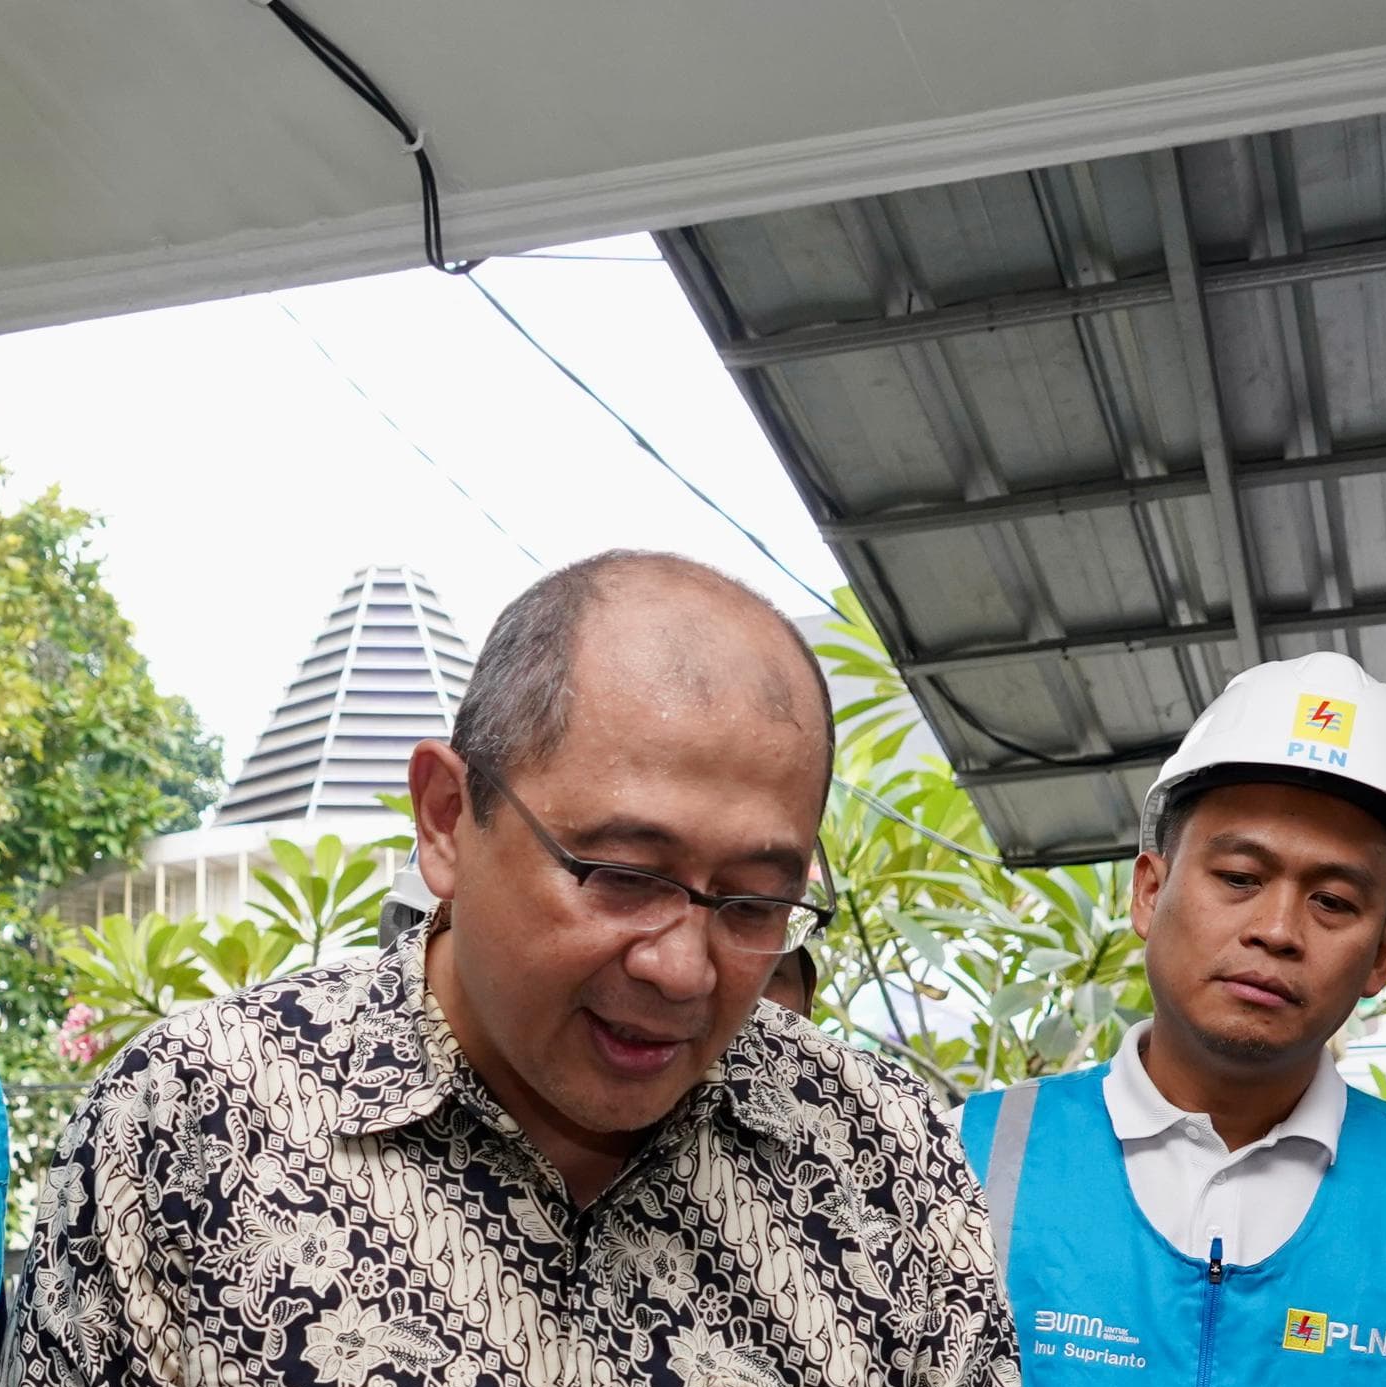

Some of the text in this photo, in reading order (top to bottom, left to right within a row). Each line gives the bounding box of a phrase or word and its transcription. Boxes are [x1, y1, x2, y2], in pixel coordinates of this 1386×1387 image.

[1287, 742, 1347, 768] PLN
[1035, 1310, 1103, 1339] BUMN
[1034, 1339, 1147, 1368] Inu Suprianto
